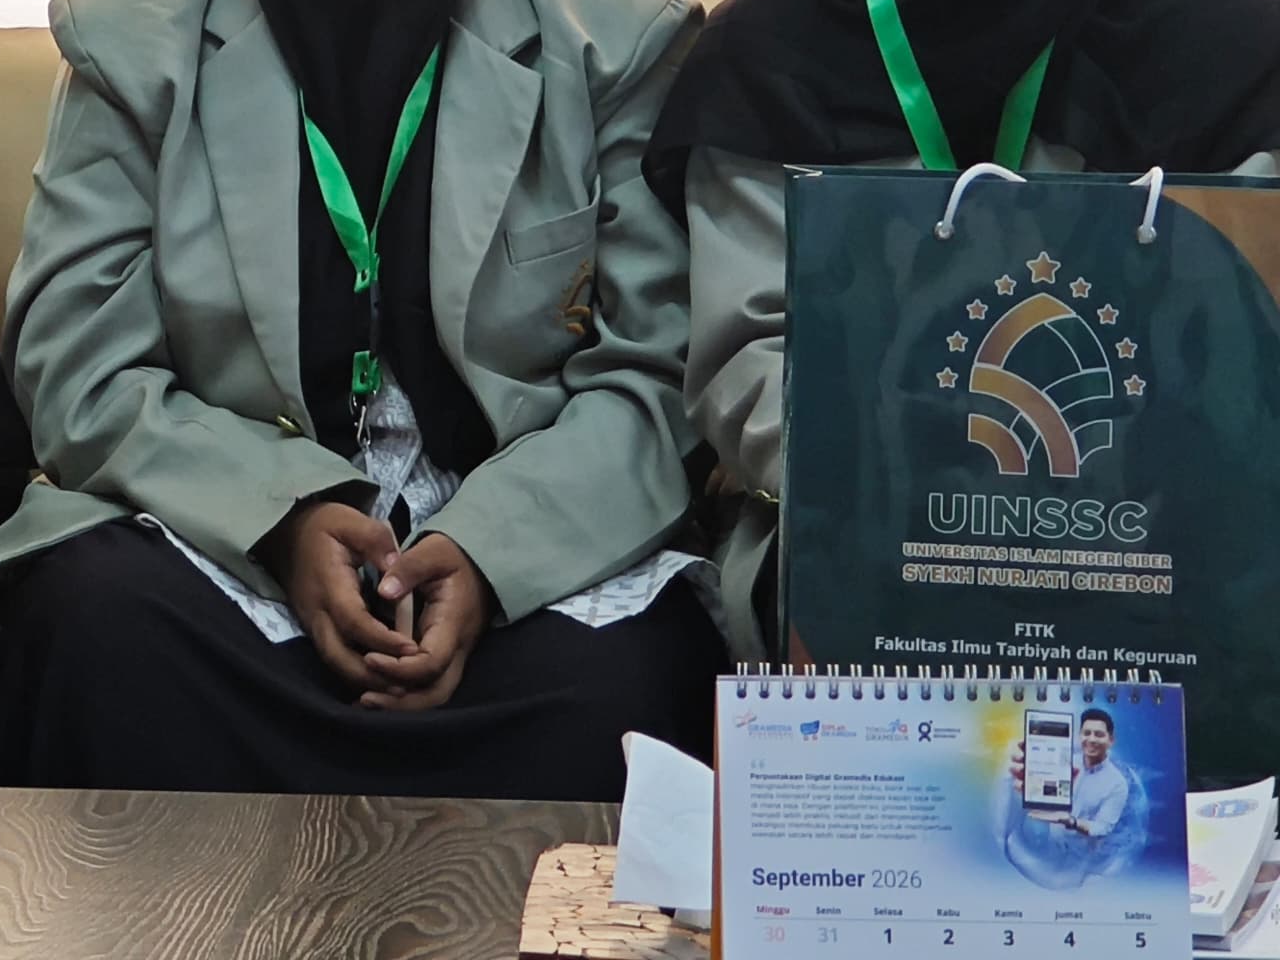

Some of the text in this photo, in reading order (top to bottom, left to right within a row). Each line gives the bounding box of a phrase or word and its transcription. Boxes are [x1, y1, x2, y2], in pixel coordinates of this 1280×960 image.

[928, 492, 1148, 542] UINSSC
[902, 542, 1172, 569] UNIVERSITAS ISLAM NEGERI SIBER
[902, 563, 1173, 594] SYEKH NURJATI CIREBON
[1014, 623, 1056, 638] FITK
[874, 636, 1197, 666] Fakultas Ilmu Tarbiyah dan Keguruan
[752, 868, 923, 891] September 2026
[756, 905, 1152, 921] Minggu Senin Selasa Rabu Kamis Jumat Sabtu
[764, 926, 1146, 948] 30 31 1 2 3 4 5
